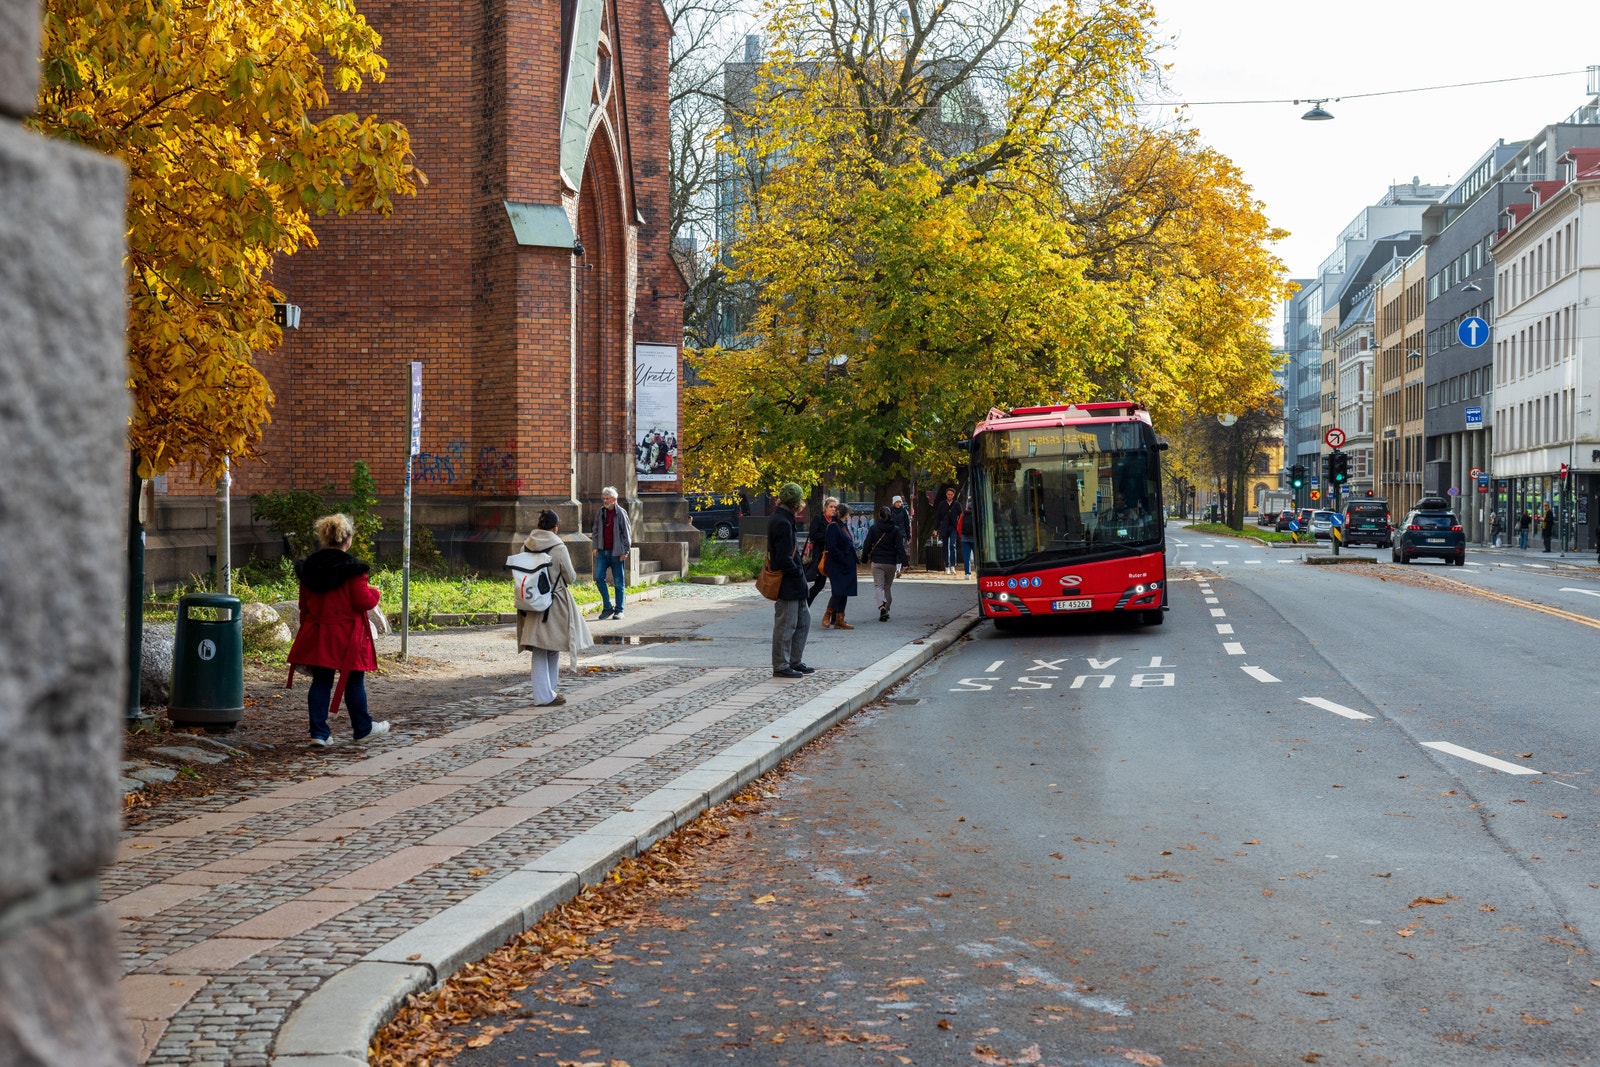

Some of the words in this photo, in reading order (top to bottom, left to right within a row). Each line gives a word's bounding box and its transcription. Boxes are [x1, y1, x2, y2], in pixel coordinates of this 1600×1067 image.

[635, 363, 676, 387] Urett
[1068, 600, 1090, 608] 45262
[984, 656, 1177, 672] TAXI
[949, 672, 1175, 692] BUSS
